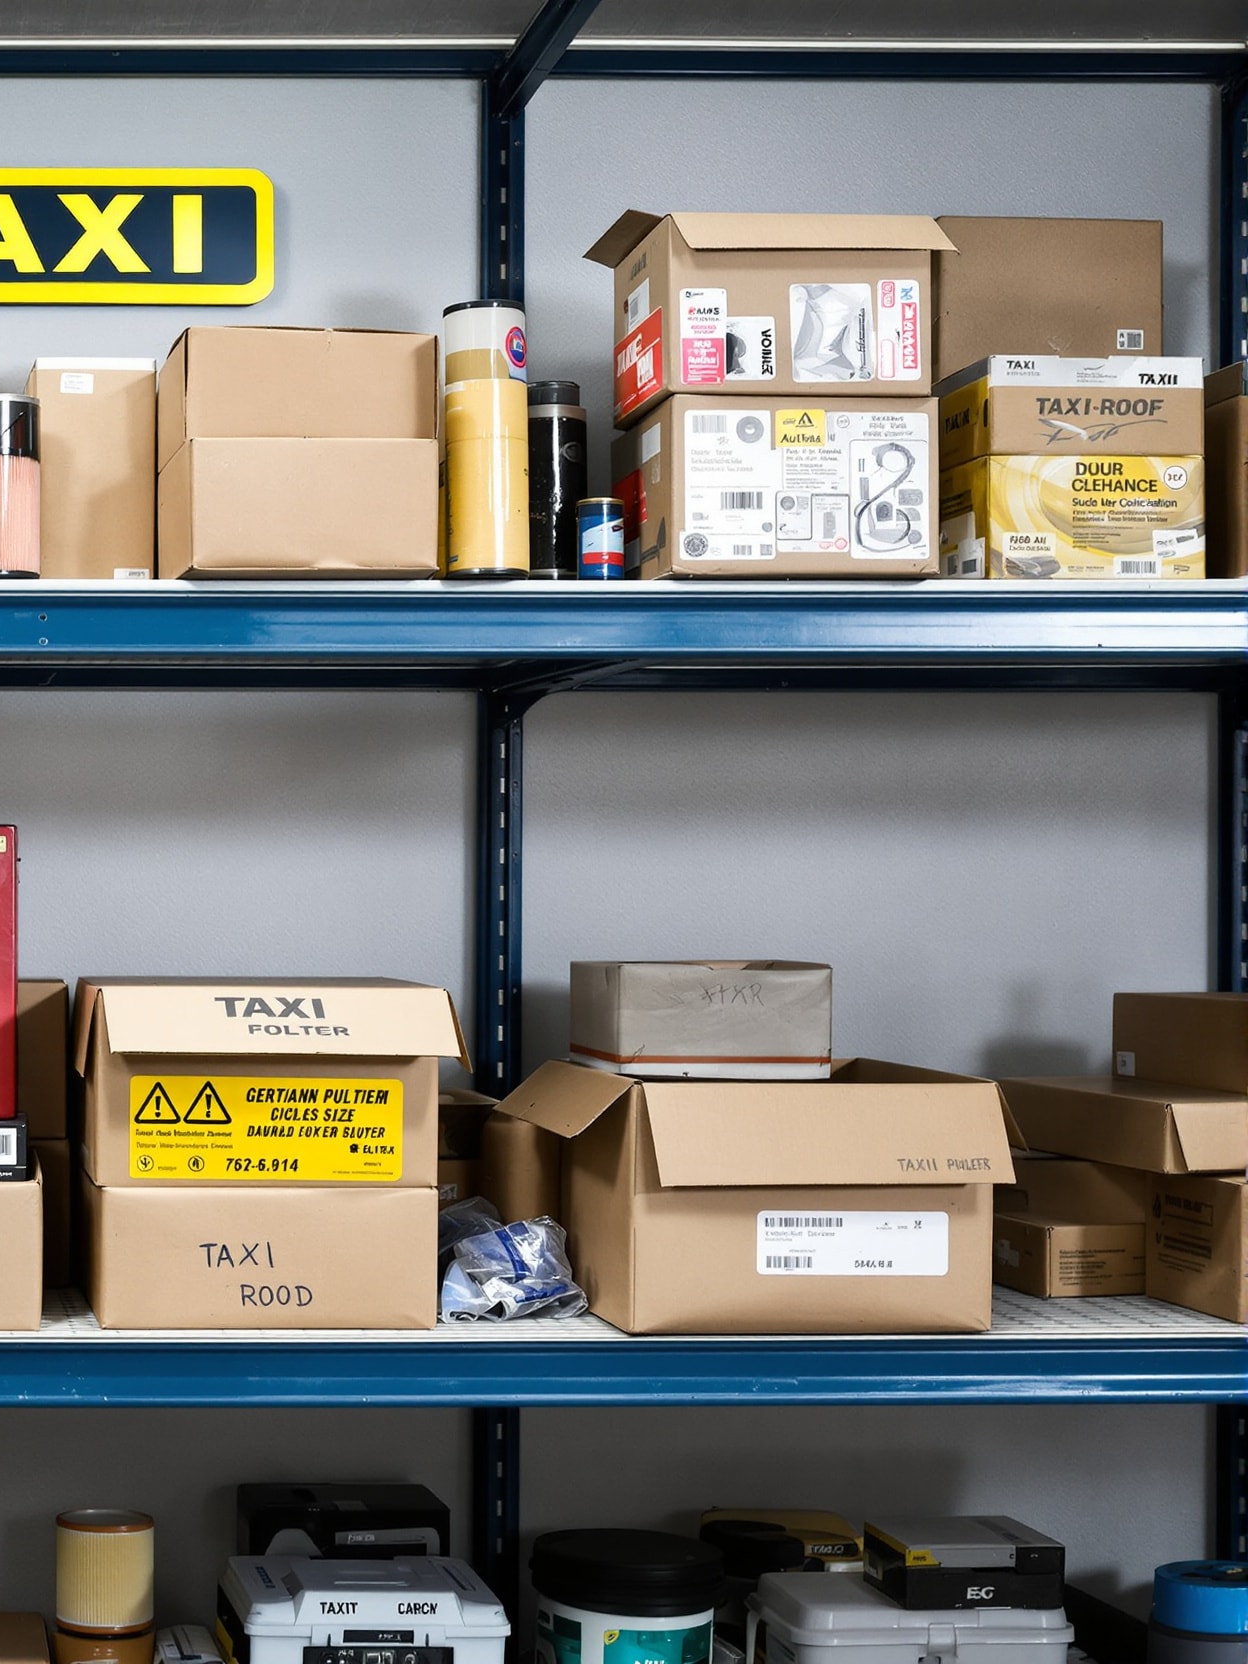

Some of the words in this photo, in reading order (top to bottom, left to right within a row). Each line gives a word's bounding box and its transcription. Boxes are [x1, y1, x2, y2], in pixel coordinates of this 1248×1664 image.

[214, 997, 326, 1019] TAXI
[248, 1024, 350, 1036] FOLTER
[199, 1242, 275, 1269] TAXI
[240, 1284, 313, 1308] ROOD
